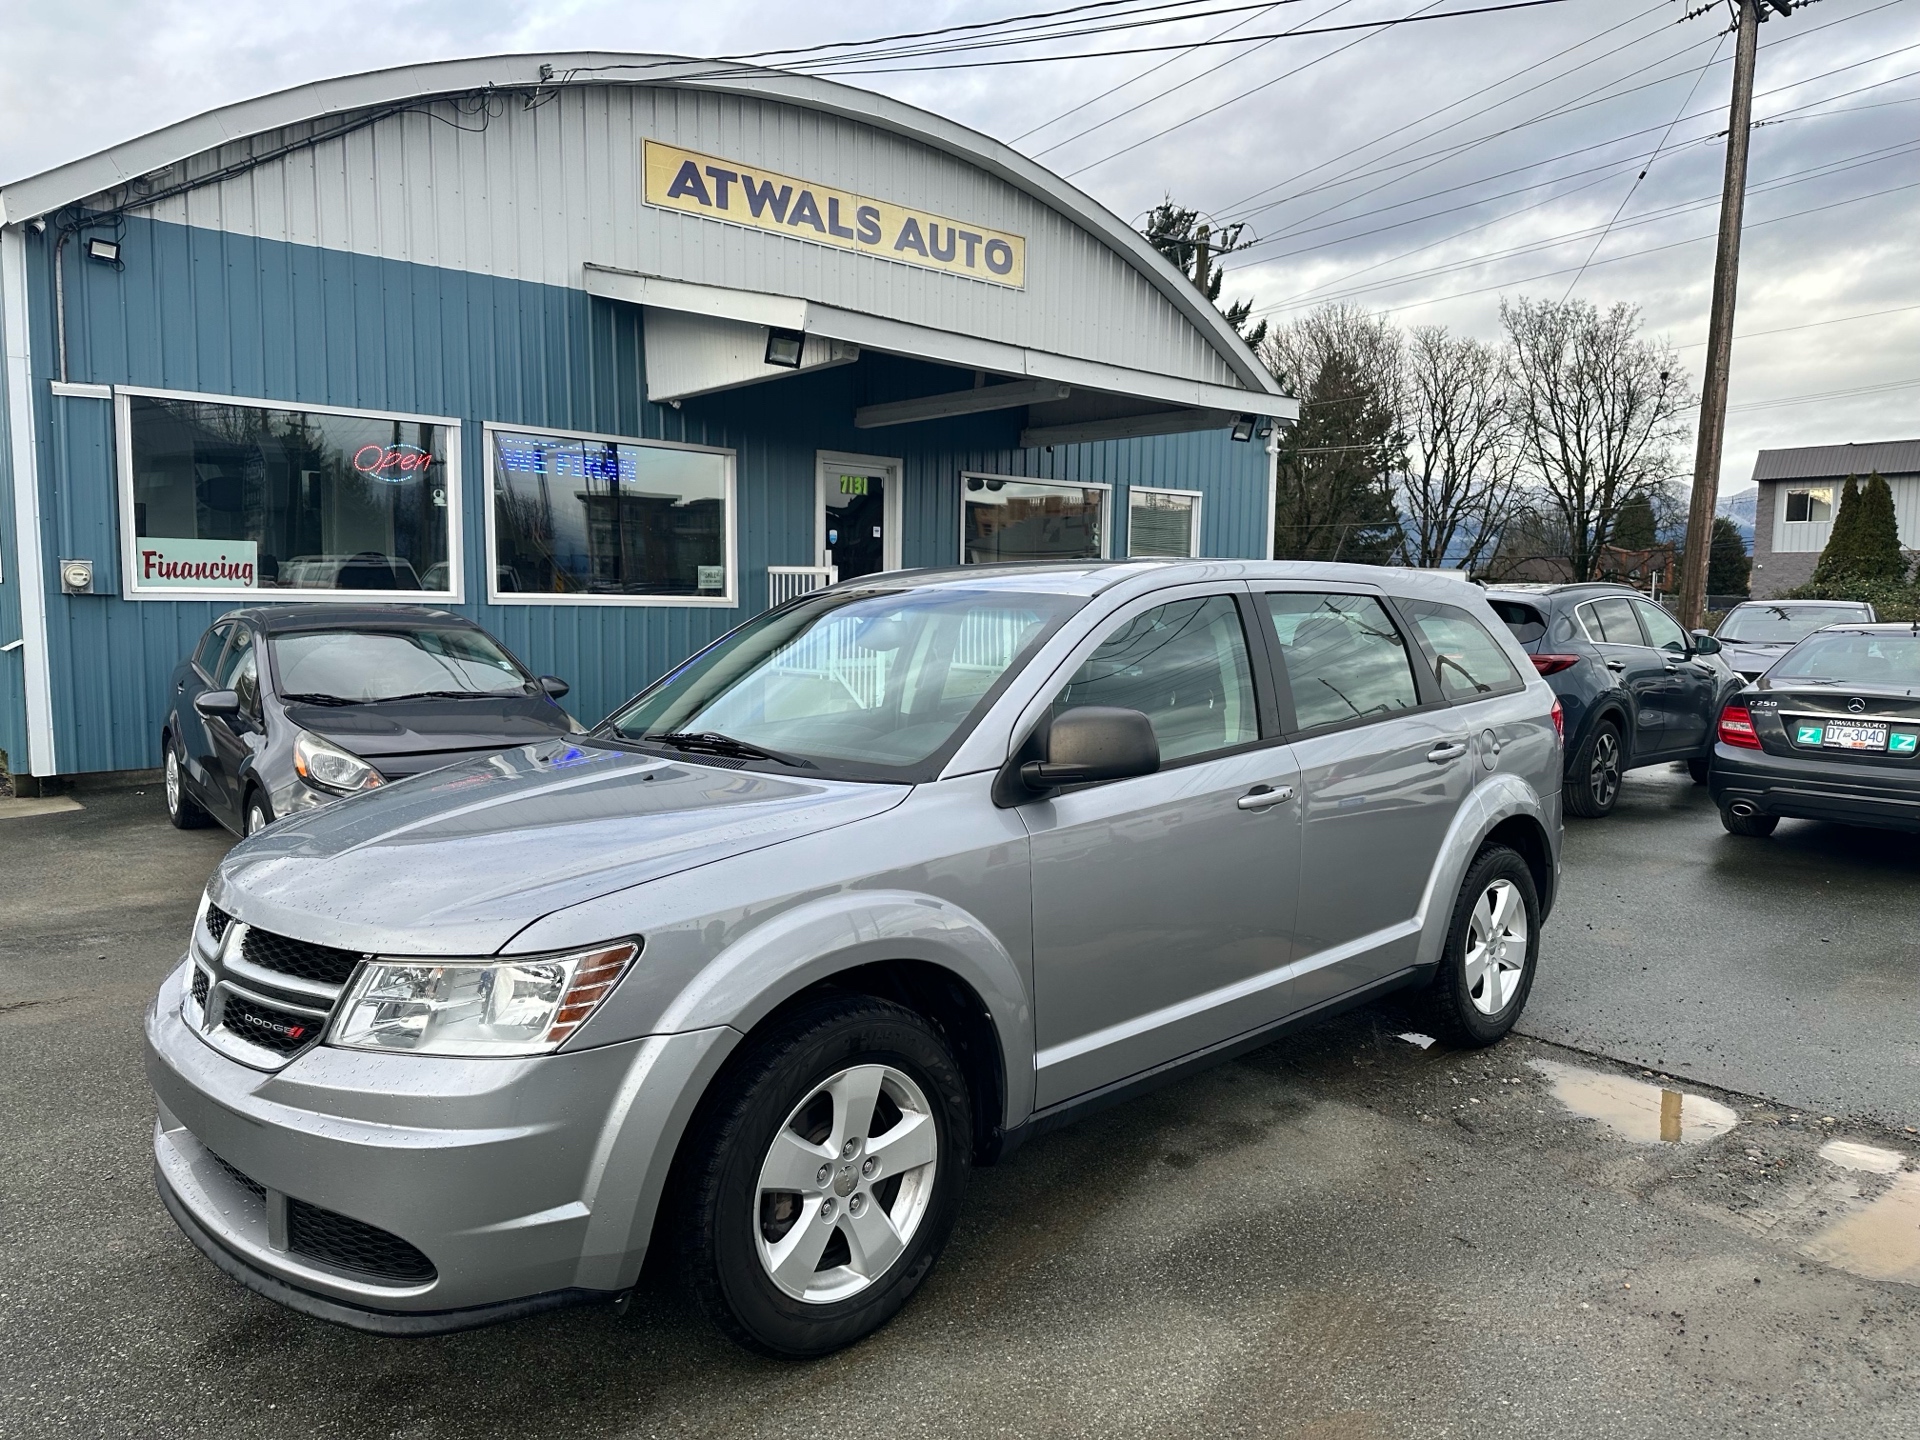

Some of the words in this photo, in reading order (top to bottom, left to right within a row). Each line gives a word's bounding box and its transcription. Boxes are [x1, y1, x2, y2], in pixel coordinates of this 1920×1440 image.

[667, 160, 882, 245] ATWALS
[894, 217, 1013, 276] AUTO
[354, 445, 432, 474] Open
[505, 448, 549, 474] WE
[840, 475, 868, 496] 7131
[142, 550, 254, 587] Financing
[1828, 719, 1860, 728] ATWALS
[244, 1013, 295, 1036] DODGE
